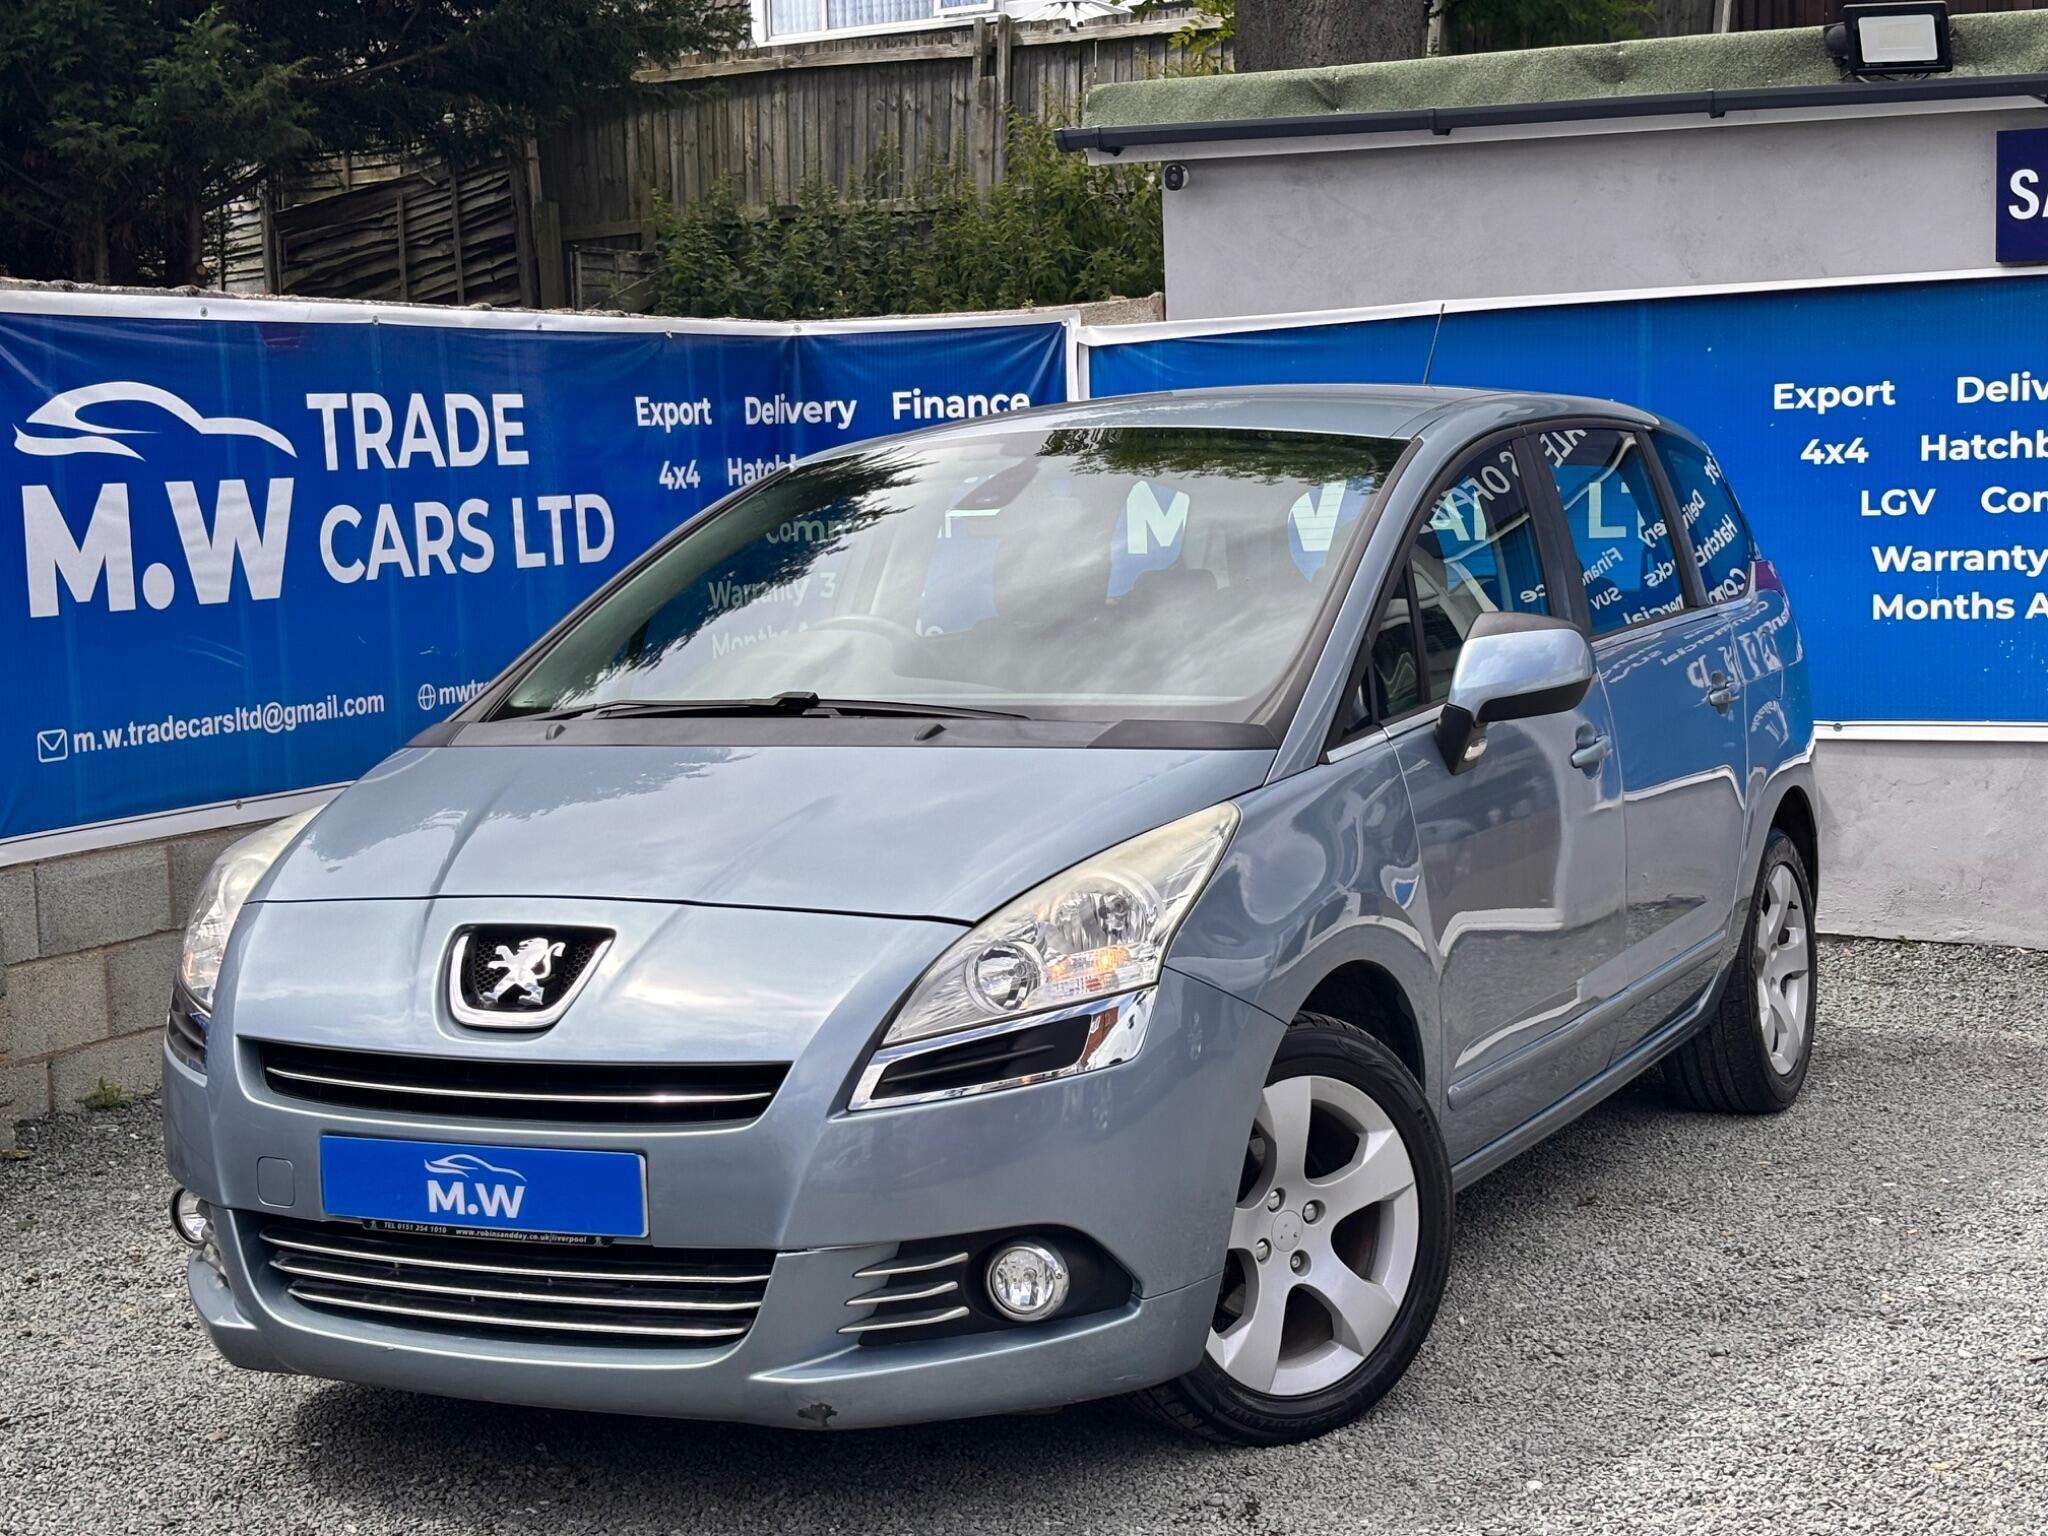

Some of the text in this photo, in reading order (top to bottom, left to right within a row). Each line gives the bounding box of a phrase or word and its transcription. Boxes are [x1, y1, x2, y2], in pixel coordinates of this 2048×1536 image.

[2008, 168, 2048, 220] S
[634, 387, 1031, 433] Export Delivery Finance
[1773, 380, 1896, 415] Export
[306, 391, 530, 471] TRADE
[1800, 437, 1870, 465] 4x4
[659, 459, 701, 491] 4x4
[1861, 488, 1937, 517] LGV
[22, 477, 294, 618] M.W
[319, 493, 615, 584] CARS LTD
[1870, 544, 2048, 578] Warranty
[1872, 591, 2016, 621] Months
[73, 694, 386, 754] m.w.tradecarsltd@gmail.com
[427, 1179, 526, 1219] M.W
[384, 1221, 396, 1230] TEL
